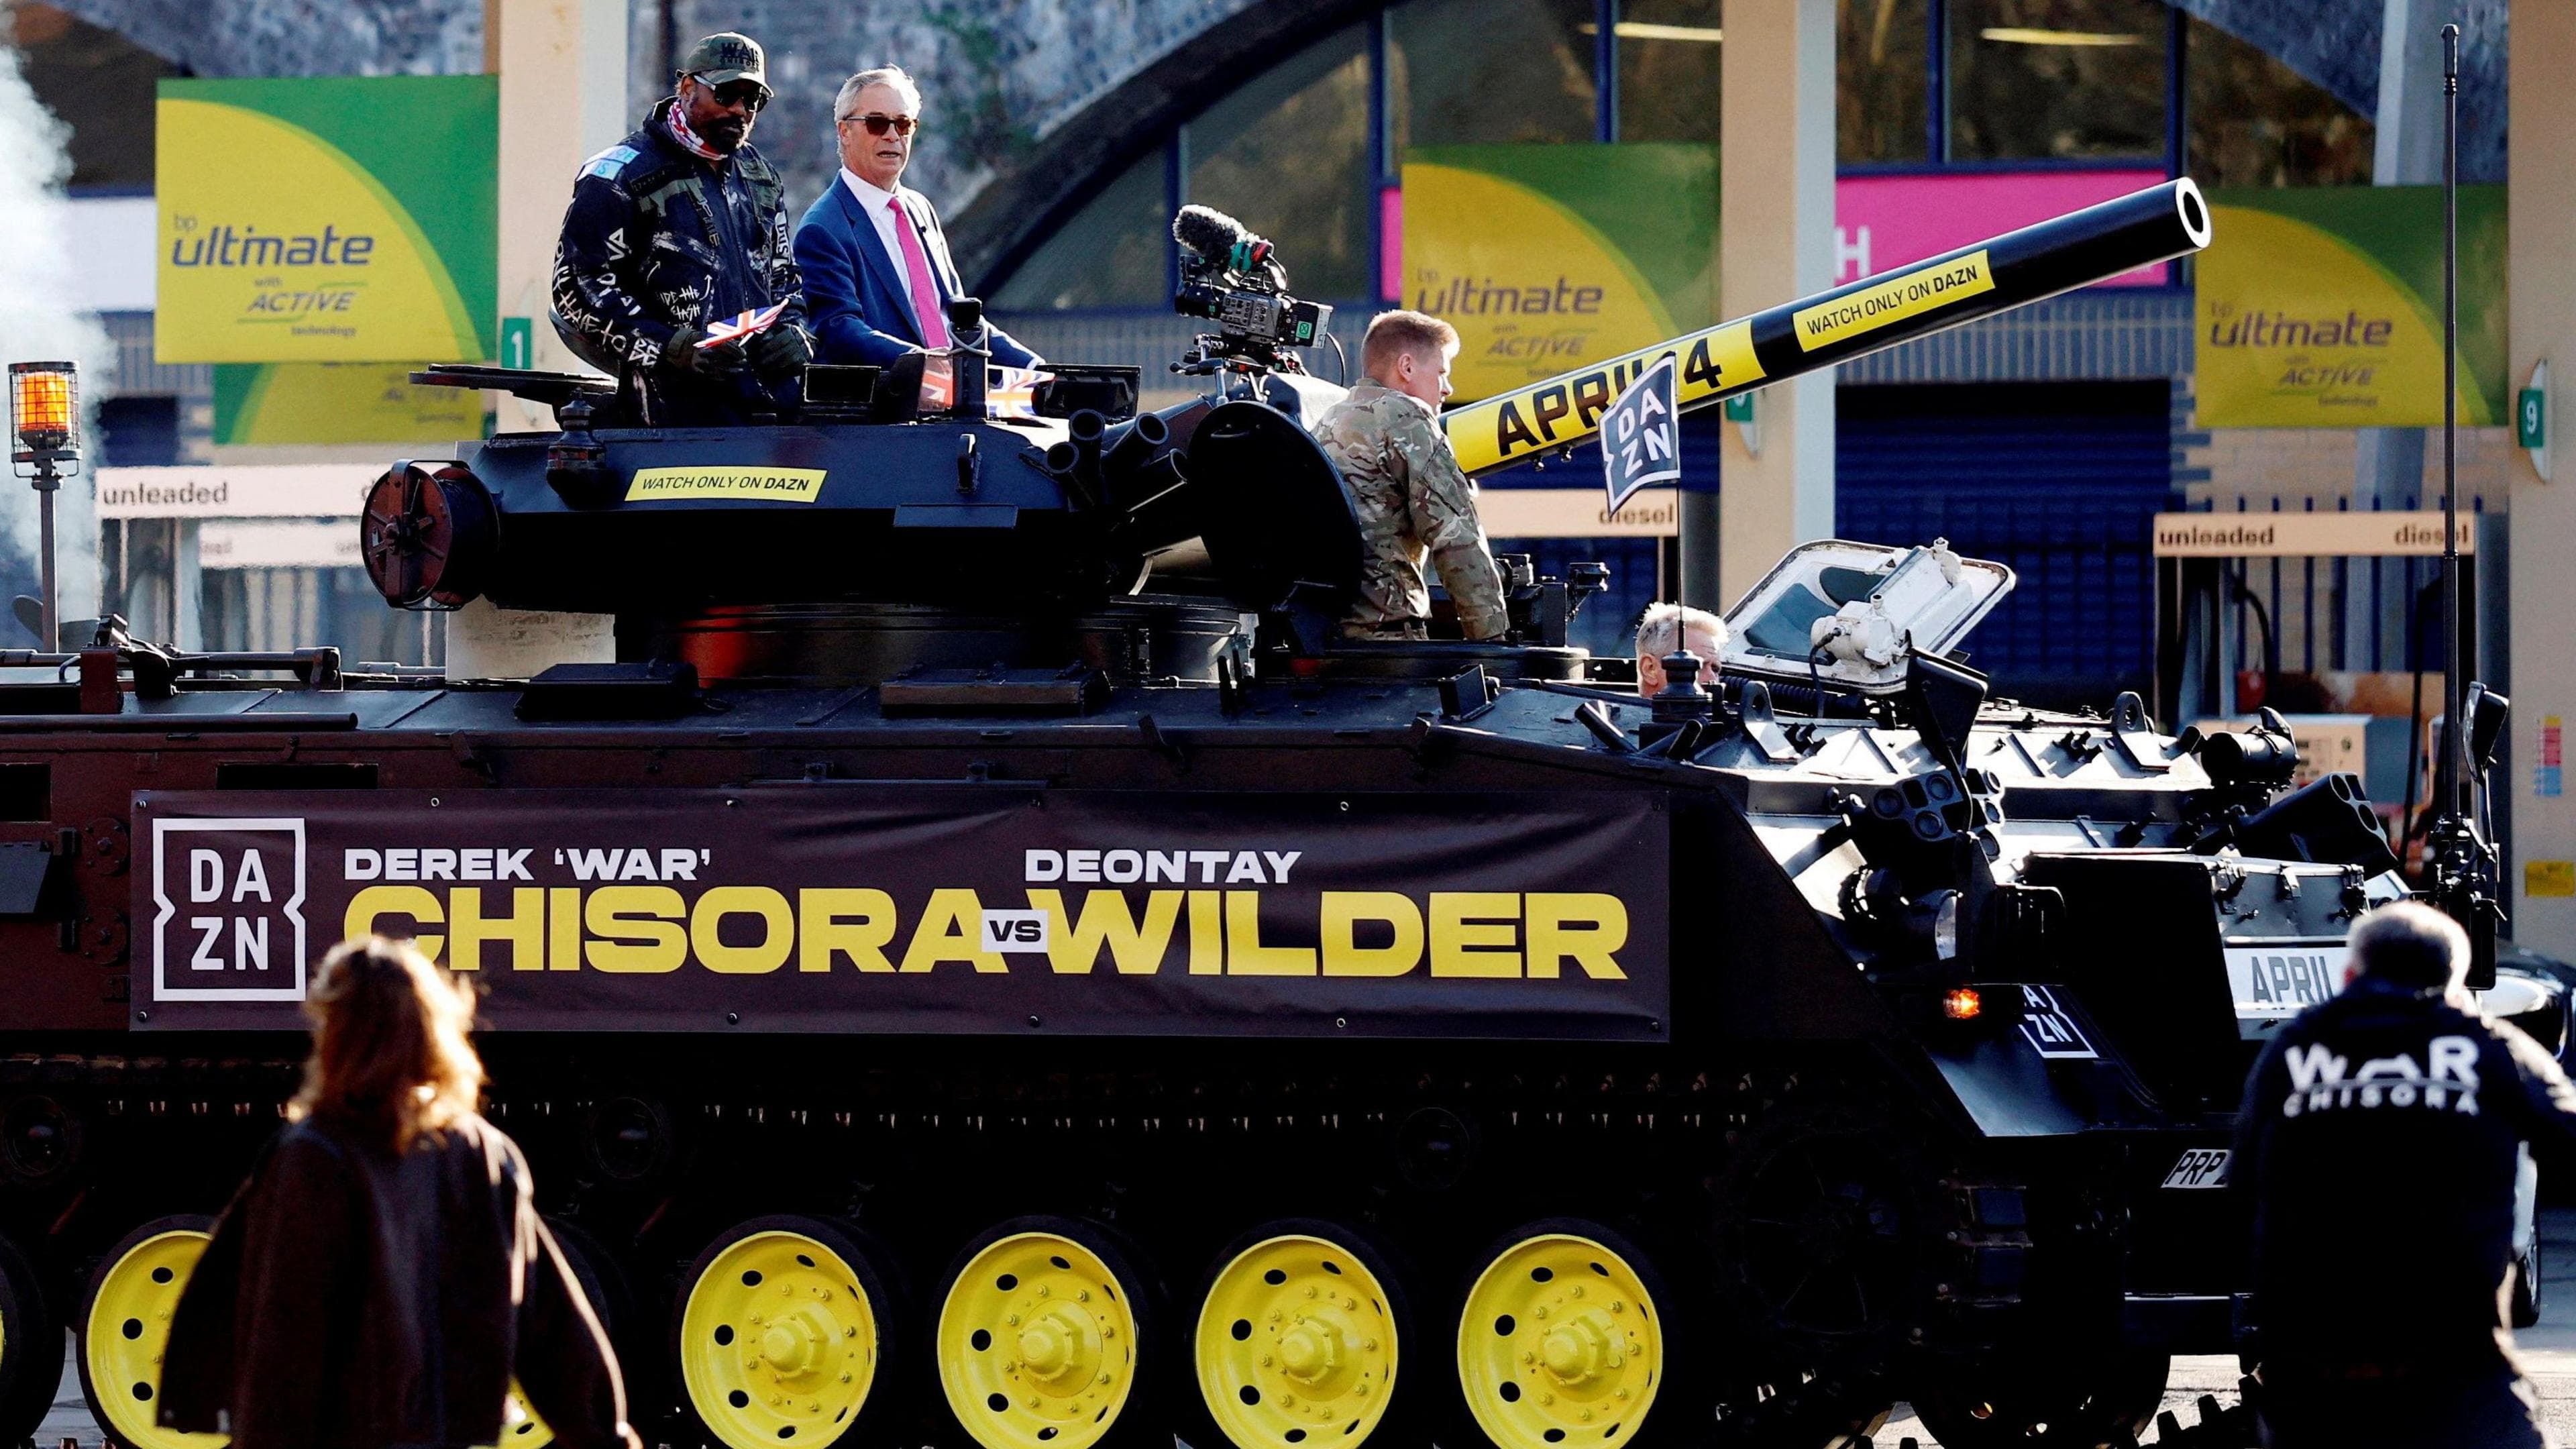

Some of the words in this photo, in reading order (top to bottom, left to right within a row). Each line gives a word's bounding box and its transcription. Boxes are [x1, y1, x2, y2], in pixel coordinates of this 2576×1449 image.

[172, 225, 374, 266] ultimate
[248, 291, 355, 313] ACTIVE
[1416, 275, 1603, 315] ultimate
[1807, 304, 1862, 335] WATCH
[1866, 290, 1903, 316] ONLY
[1908, 281, 1930, 301] ON
[1933, 265, 1978, 292] DAZN
[2210, 311, 2393, 347] ultimate
[512, 331, 524, 368] 1
[1683, 337, 1722, 389] 4
[1618, 388, 1666, 443] DA
[2526, 400, 2538, 435] 9
[1622, 423, 1672, 478] ZN
[103, 481, 229, 506] unleaded
[643, 477, 695, 490] WATCH
[696, 476, 737, 488] ONLY
[739, 477, 763, 489] ON
[763, 478, 810, 492] DAZN
[2159, 523, 2275, 546] unleaded
[191, 849, 272, 903] DA
[344, 848, 535, 881] DEREK
[1025, 849, 1302, 884] DEONTAY
[191, 916, 269, 971] ZN
[343, 885, 1010, 975] CHISORA
[988, 919, 1042, 943] VS
[1025, 888, 1629, 980] WILDER
